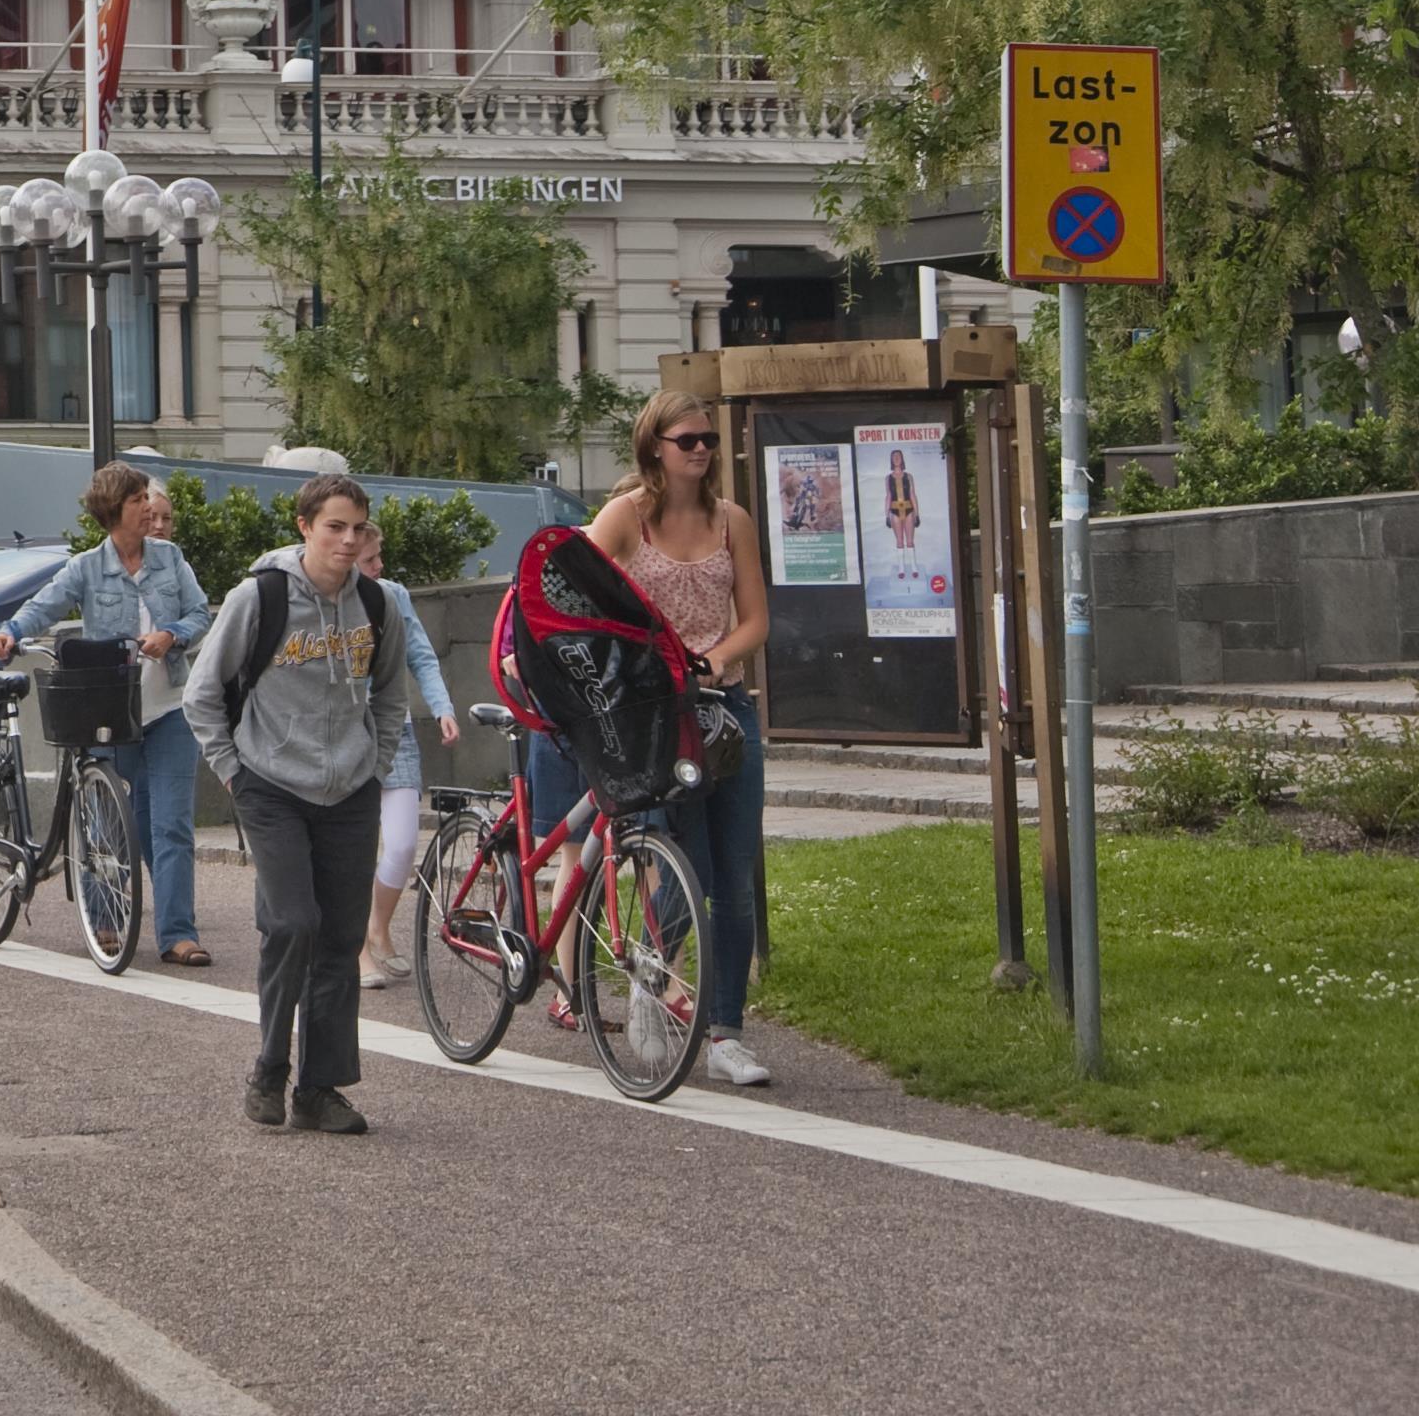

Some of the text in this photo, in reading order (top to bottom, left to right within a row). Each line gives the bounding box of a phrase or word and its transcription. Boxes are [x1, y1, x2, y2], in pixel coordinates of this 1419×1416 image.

[1032, 67, 1137, 101] Last-
[1049, 120, 1121, 146] zon
[743, 354, 907, 387] KONSTHALL
[859, 427, 941, 442] SPORT I KONSTEN
